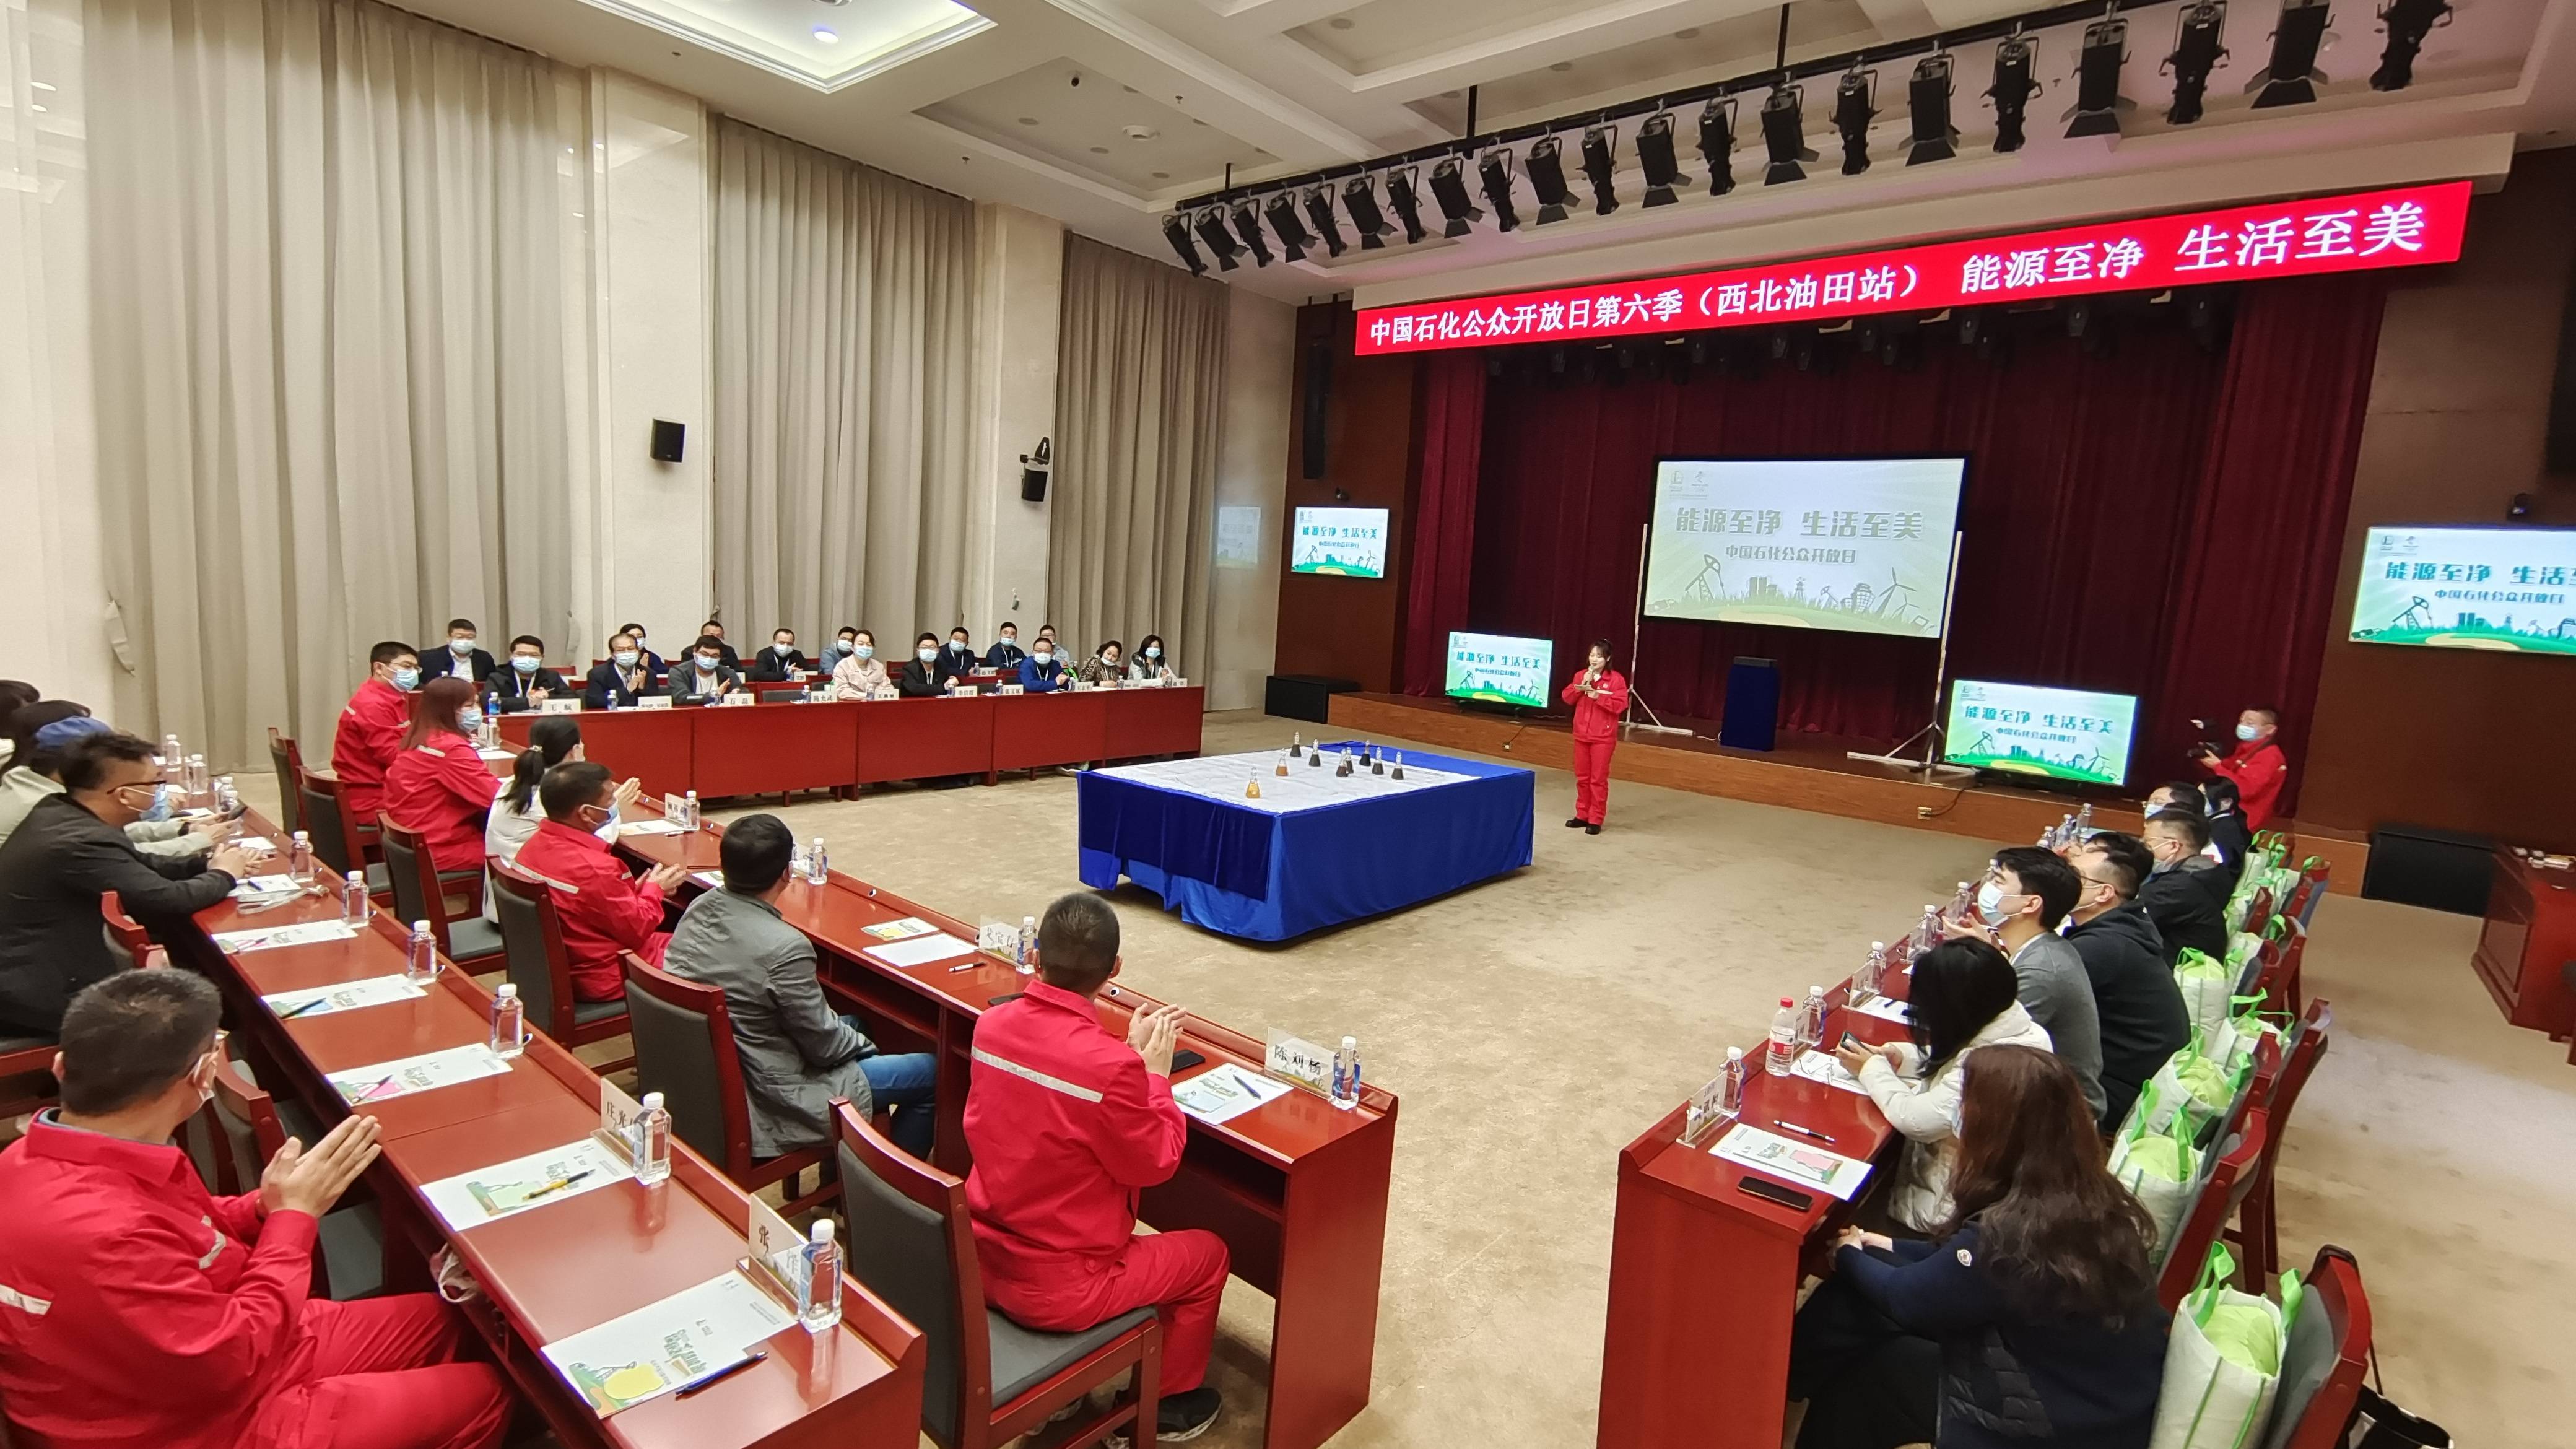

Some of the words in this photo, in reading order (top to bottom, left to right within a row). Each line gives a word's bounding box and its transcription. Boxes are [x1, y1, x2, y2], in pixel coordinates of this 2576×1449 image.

[1369, 264, 1917, 347] 中国石化公众开放日第六季（西北油田站）
[1960, 238, 2144, 294] 能源至净
[2174, 202, 2426, 273] 生活至美
[1676, 507, 1782, 535] 能源至净
[1801, 511, 1923, 539] 生活至美
[1725, 544, 1857, 564] 中国石化公众开放日
[2385, 562, 2492, 583] 能源至净
